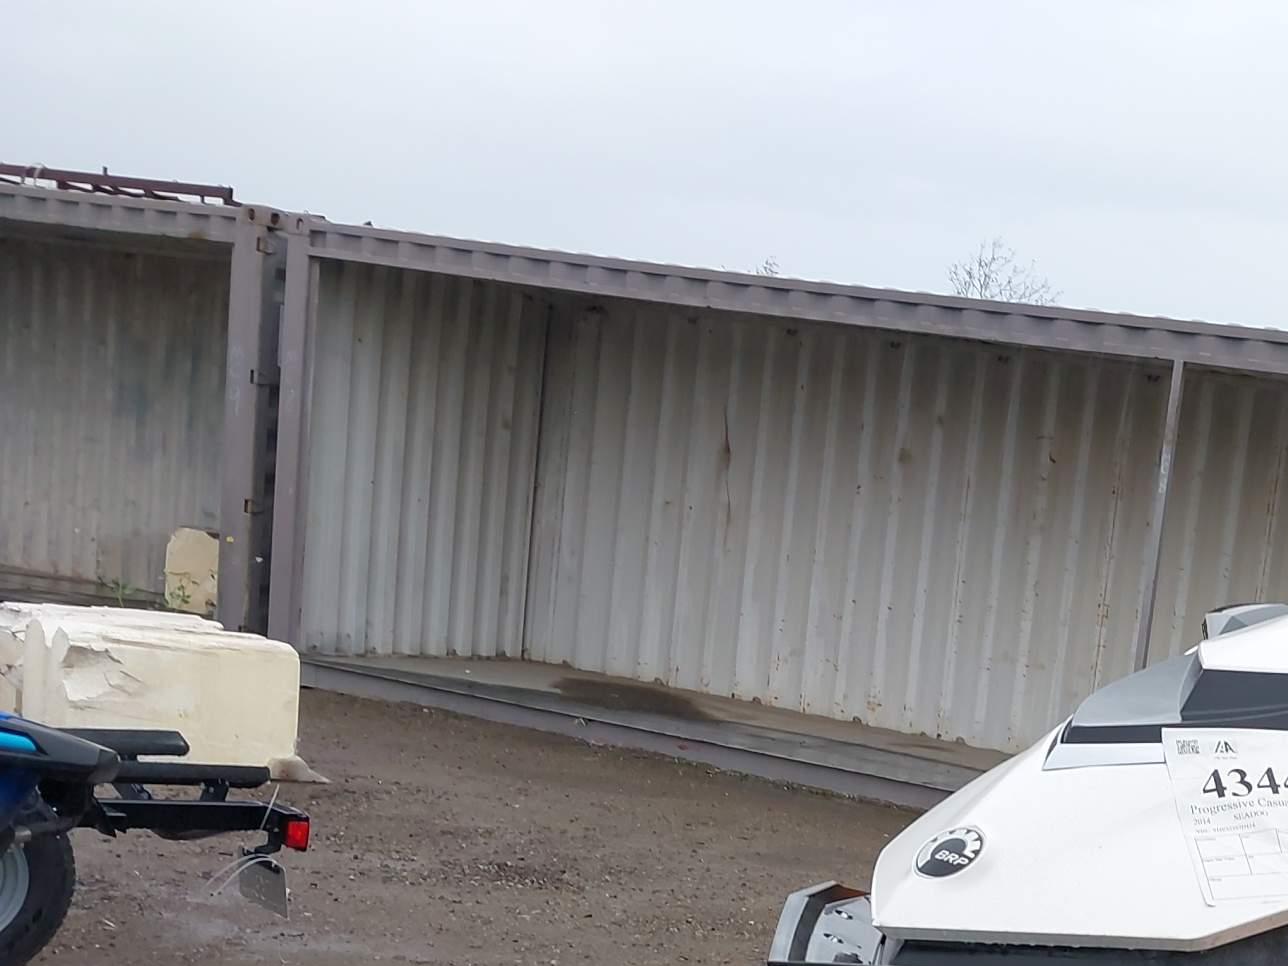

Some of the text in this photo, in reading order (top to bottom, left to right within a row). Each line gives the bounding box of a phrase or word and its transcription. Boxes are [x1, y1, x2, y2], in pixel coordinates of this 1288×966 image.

[1190, 799, 1255, 815] Progressive
[1193, 818, 1211, 826] 2014
[934, 849, 969, 866] BRP
